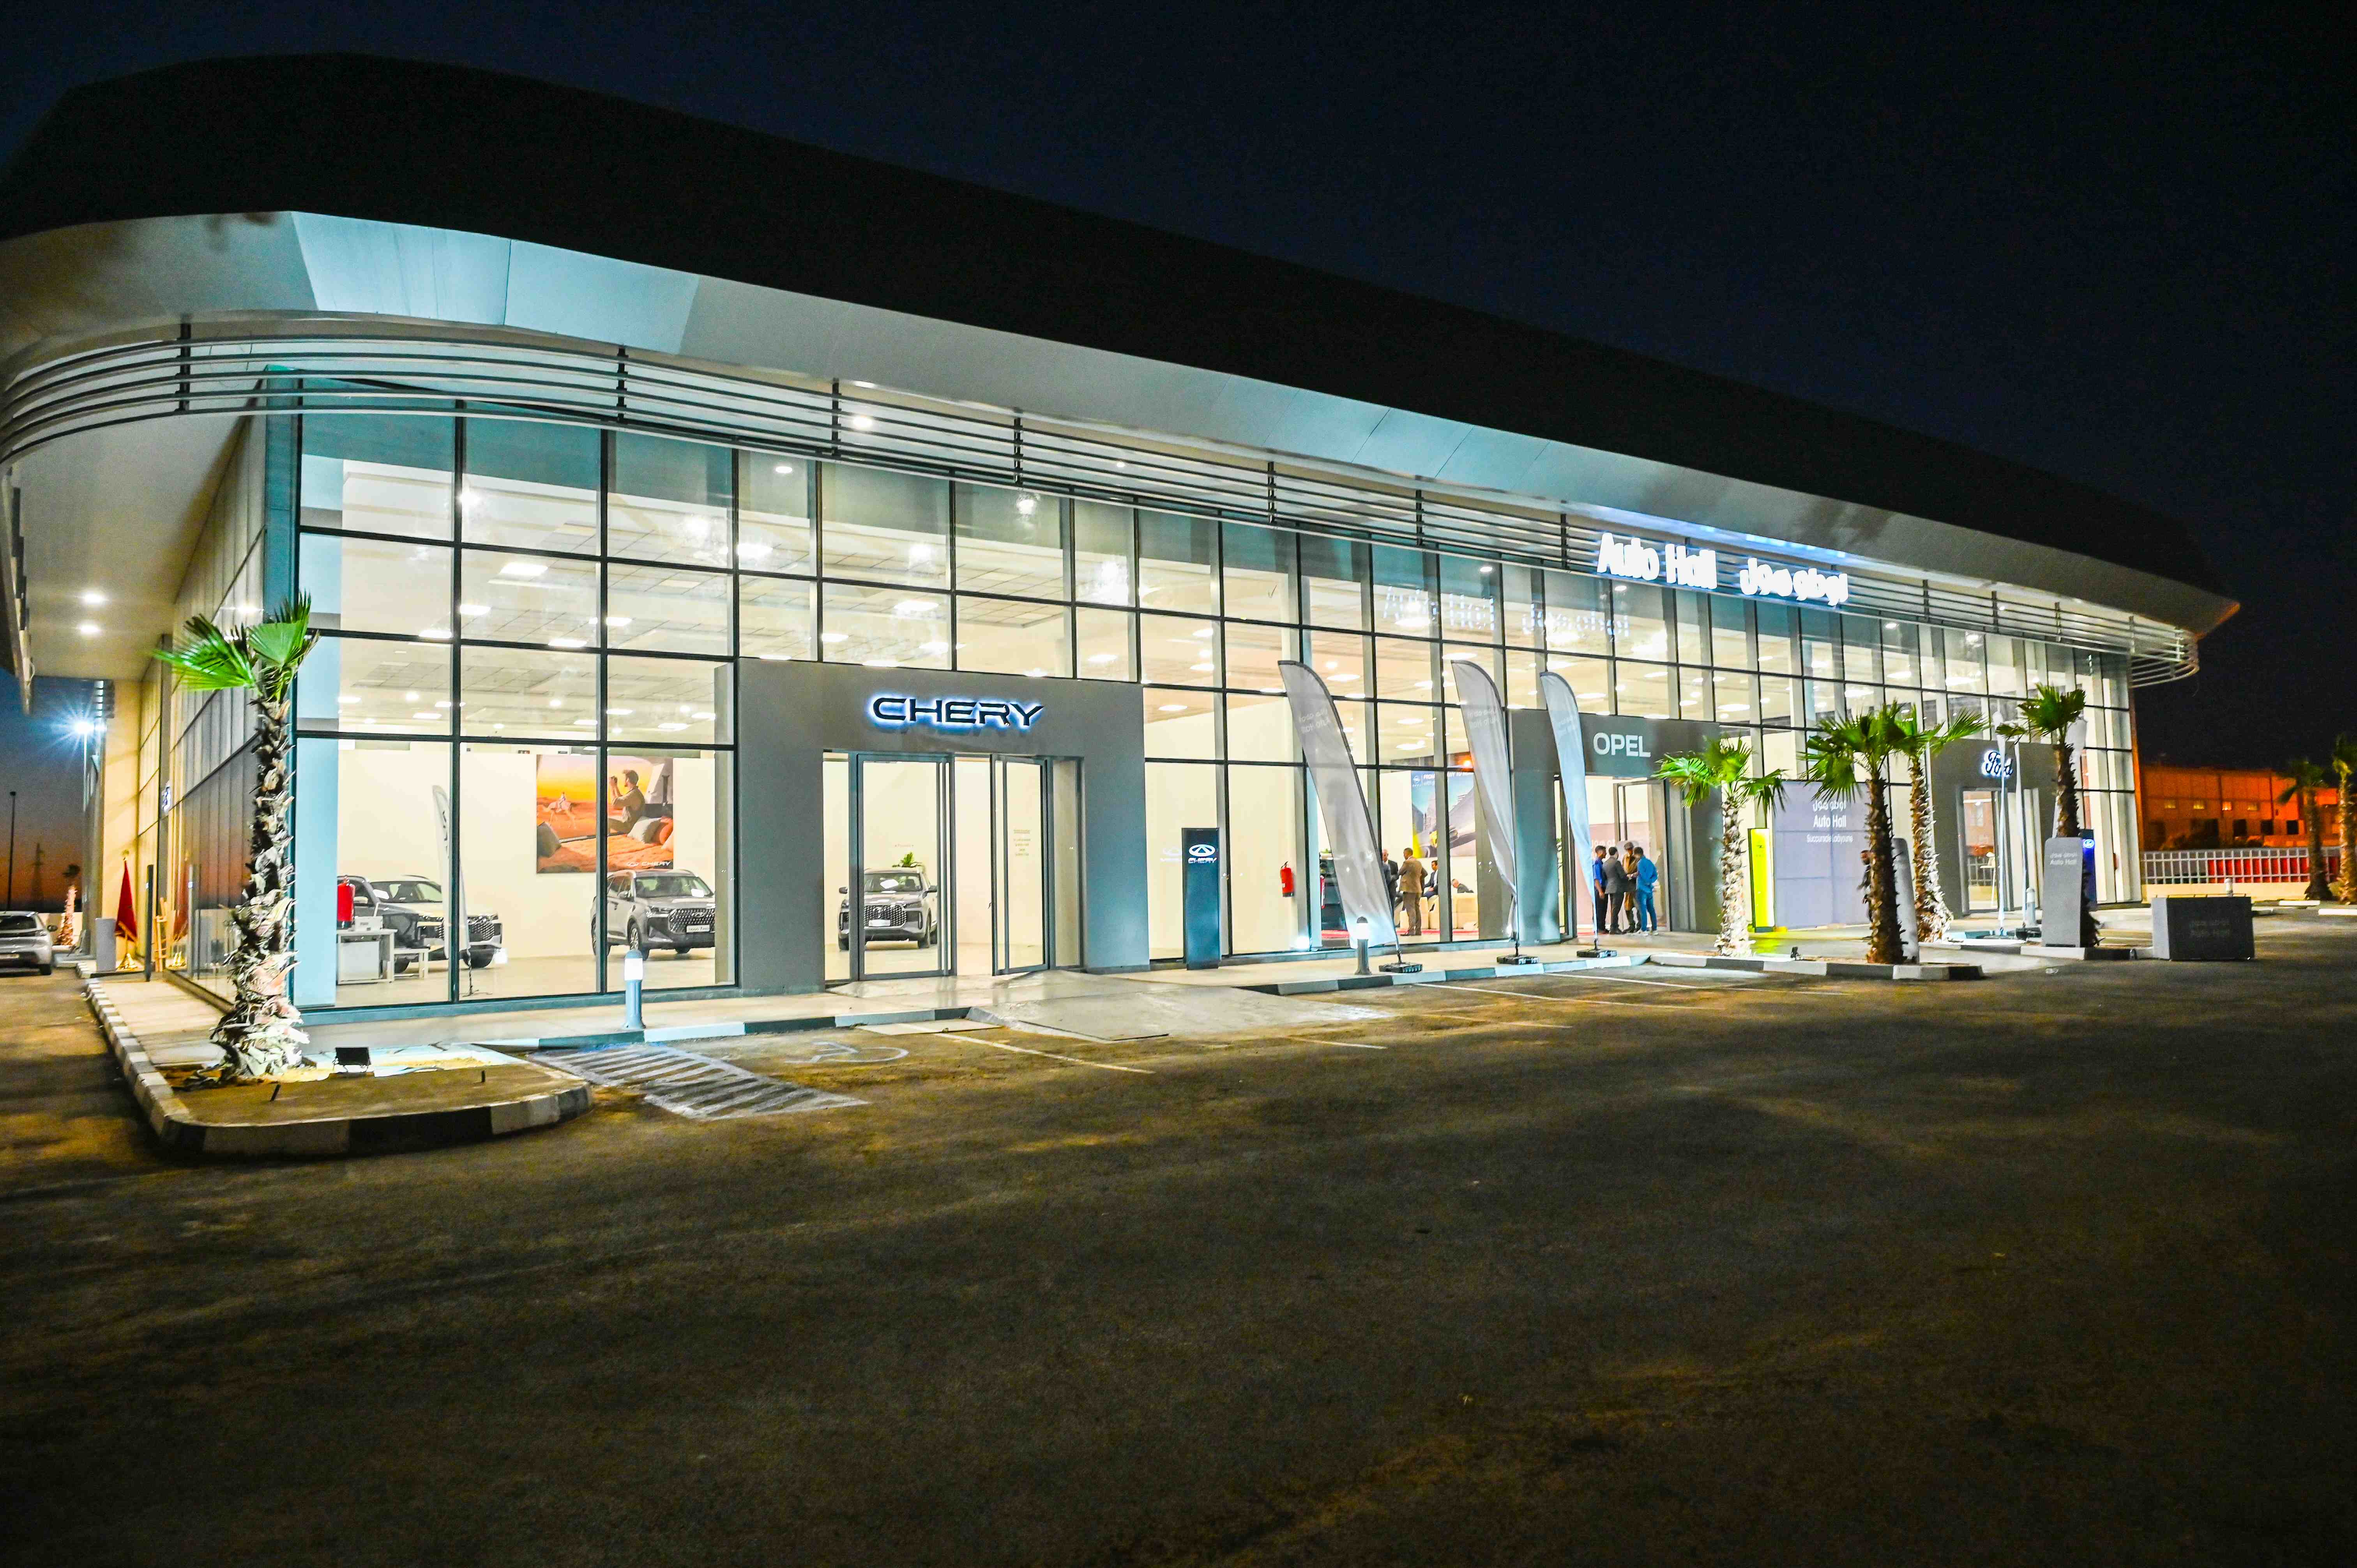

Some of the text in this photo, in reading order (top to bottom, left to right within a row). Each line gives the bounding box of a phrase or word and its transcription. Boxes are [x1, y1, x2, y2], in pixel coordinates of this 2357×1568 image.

[1597, 533, 1717, 589] Auto Hall
[873, 697, 1044, 726] CHERY
[1593, 732, 1651, 758] OPEL
[1813, 814, 1846, 828] Auto Hall
